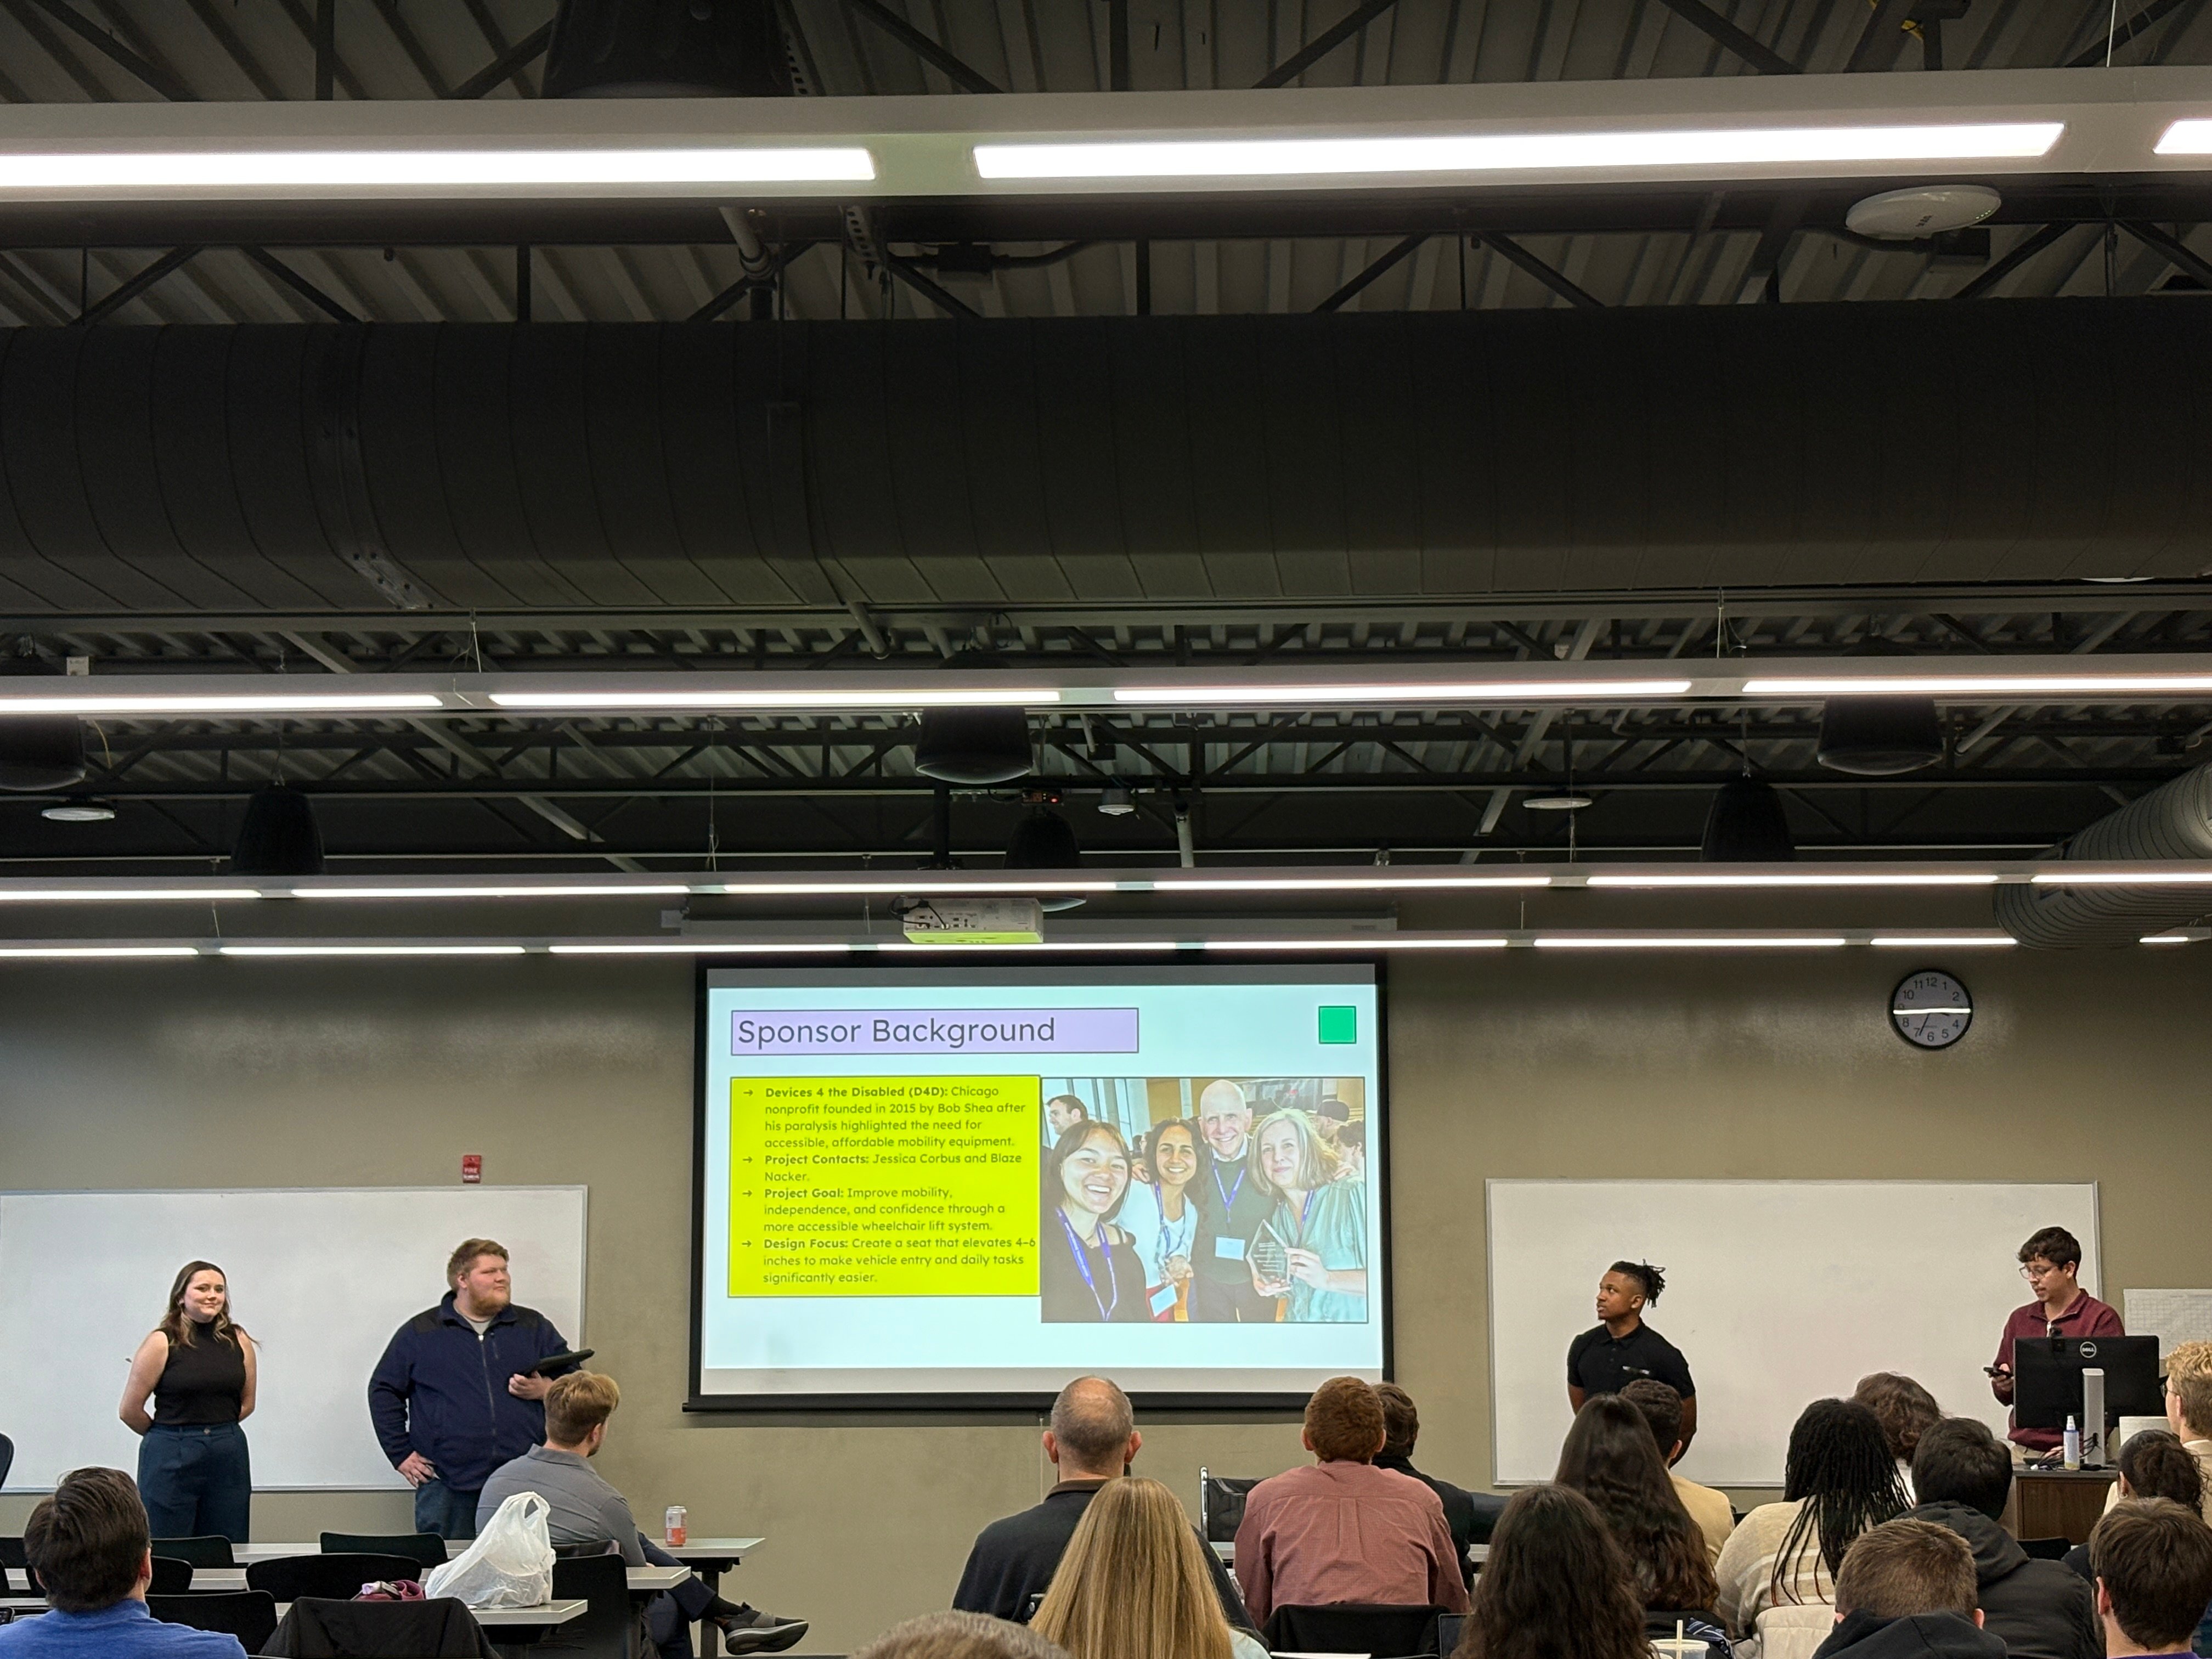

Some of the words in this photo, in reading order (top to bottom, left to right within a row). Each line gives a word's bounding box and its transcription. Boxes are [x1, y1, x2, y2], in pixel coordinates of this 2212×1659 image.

[1914, 981, 1923, 989] 11
[1926, 977, 1937, 986] 12
[1903, 990, 1914, 1000] 10
[1952, 992, 1959, 1001] 2
[1902, 1018, 1909, 1027] 8
[1952, 1019, 1959, 1029] 4
[738, 1020, 861, 1049] Sponsor
[873, 1017, 1056, 1047] Background
[1914, 1028, 1920, 1037] 7
[1927, 1031, 1934, 1042] 6
[1942, 1029, 1949, 1038] 5
[766, 1087, 812, 1097] Devices
[816, 1088, 824, 1097] 4
[828, 1087, 847, 1097] the
[852, 1086, 904, 1097] Disabled
[909, 1087, 948, 1098] (D4D):
[951, 1086, 998, 1098] Chicago
[765, 1104, 819, 1116] nonprofit
[823, 1104, 872, 1114] founded
[876, 1103, 885, 1113] in
[890, 1103, 916, 1113] 2015
[919, 1103, 934, 1115] by
[938, 1103, 960, 1113] Bob
[964, 1103, 993, 1113] Shea
[997, 1103, 1026, 1113] after
[765, 1121, 781, 1131] his
[785, 1120, 837, 1133] paralysis
[841, 1120, 906, 1133] highlighted
[911, 1120, 929, 1130] the
[933, 1120, 961, 1130] need
[966, 1120, 982, 1130] for
[765, 1137, 828, 1149] accessible,
[832, 1137, 894, 1147] affordable
[898, 1136, 946, 1149] mobility
[949, 1136, 1014, 1149] equipment.
[765, 1154, 808, 1166] Project
[812, 1155, 869, 1164] Contacts:
[872, 1153, 916, 1164] Jessica
[920, 1153, 961, 1163] Corbus
[964, 1153, 986, 1163] and
[991, 1153, 1022, 1163] Blaze
[765, 1171, 809, 1181] Nacker.
[765, 1188, 808, 1200] Project
[812, 1188, 844, 1198] Goal:
[848, 1188, 898, 1200] Improve
[902, 1187, 952, 1199] mobility,
[765, 1205, 850, 1217] independence,
[854, 1204, 876, 1214] and
[879, 1204, 944, 1214] confidence
[948, 1204, 994, 1216] through
[798, 1221, 858, 1231] accessible
[862, 1221, 926, 1231] wheelchair
[929, 1221, 945, 1231] lift
[949, 1222, 992, 1233] system.
[764, 1238, 805, 1251] Design
[810, 1239, 848, 1248] Focus:
[852, 1238, 892, 1248] Create
[906, 1239, 932, 1248] seat
[935, 1238, 959, 1248] that
[963, 1238, 1012, 1247] elevates
[764, 1256, 800, 1266] inches
[804, 1257, 816, 1265] to
[820, 1255, 852, 1265] make
[856, 1255, 897, 1265] vehicle
[901, 1256, 932, 1267] entry
[935, 1255, 957, 1264] and
[961, 1254, 990, 1267] daily
[993, 1255, 1024, 1264] tasks
[763, 1272, 835, 1285] significantly
[839, 1272, 877, 1282] easier.
